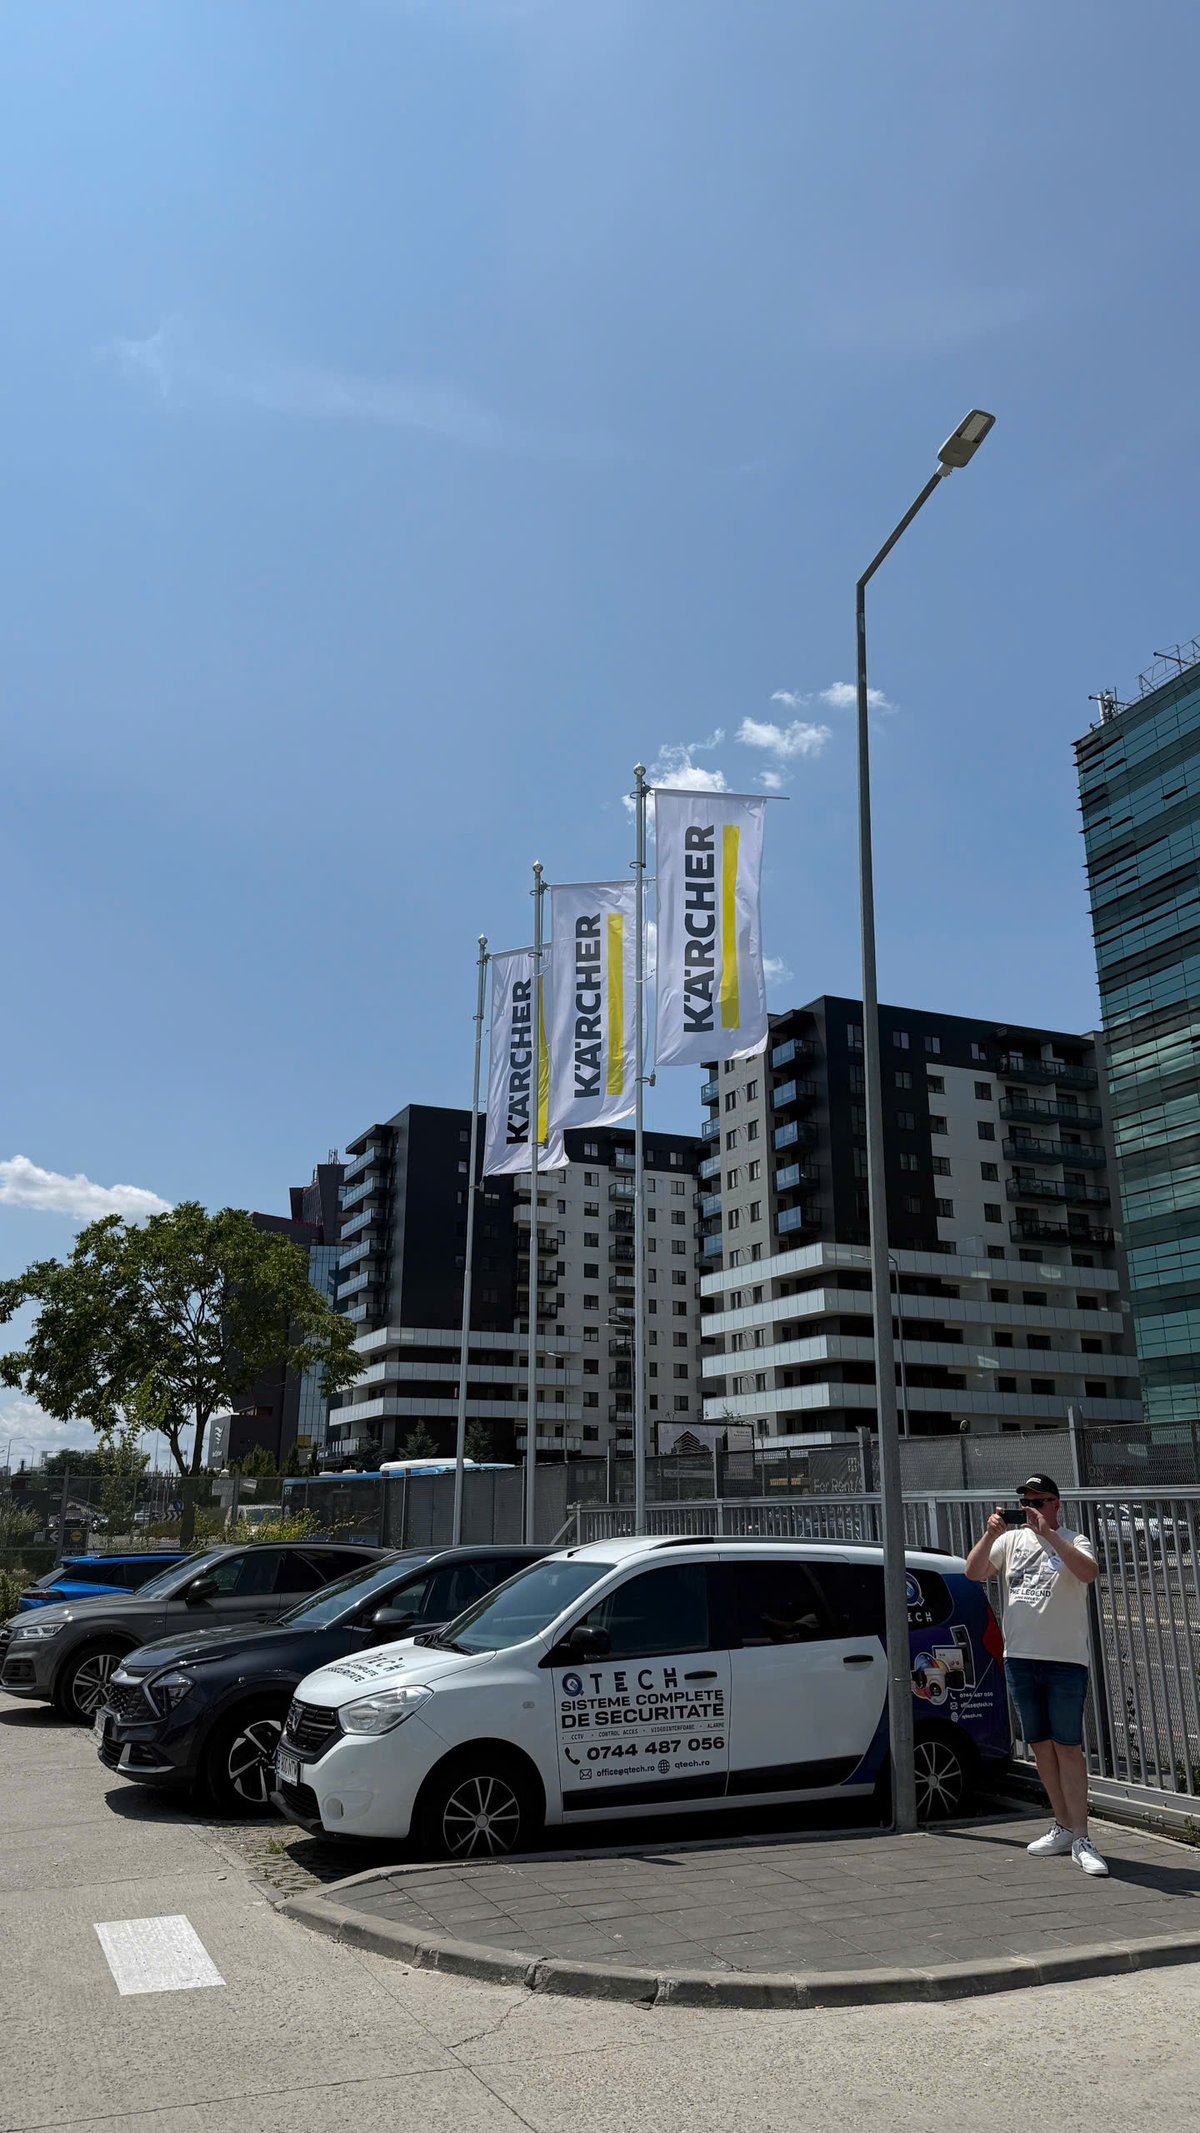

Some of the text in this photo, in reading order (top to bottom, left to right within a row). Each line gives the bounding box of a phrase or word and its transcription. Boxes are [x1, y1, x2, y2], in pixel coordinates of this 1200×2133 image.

[683, 823, 716, 1033] KÄRCHER
[573, 912, 602, 1099] KÄRCHER
[506, 977, 532, 1145] KÄRCHER
[1021, 1589, 1051, 1598] LEGEND
[907, 1611, 933, 1622] ECH
[561, 1690, 723, 1712] SISTEME COMPLETE
[561, 1703, 725, 1729] DE SECURITATE
[571, 1733, 584, 1741] CCTV
[598, 1729, 620, 1738] CONTROL
[623, 1728, 639, 1736] ACCES
[587, 1736, 725, 1761] 0744 487 056
[596, 1759, 711, 1778] office@qtech.ro qtech.ro
